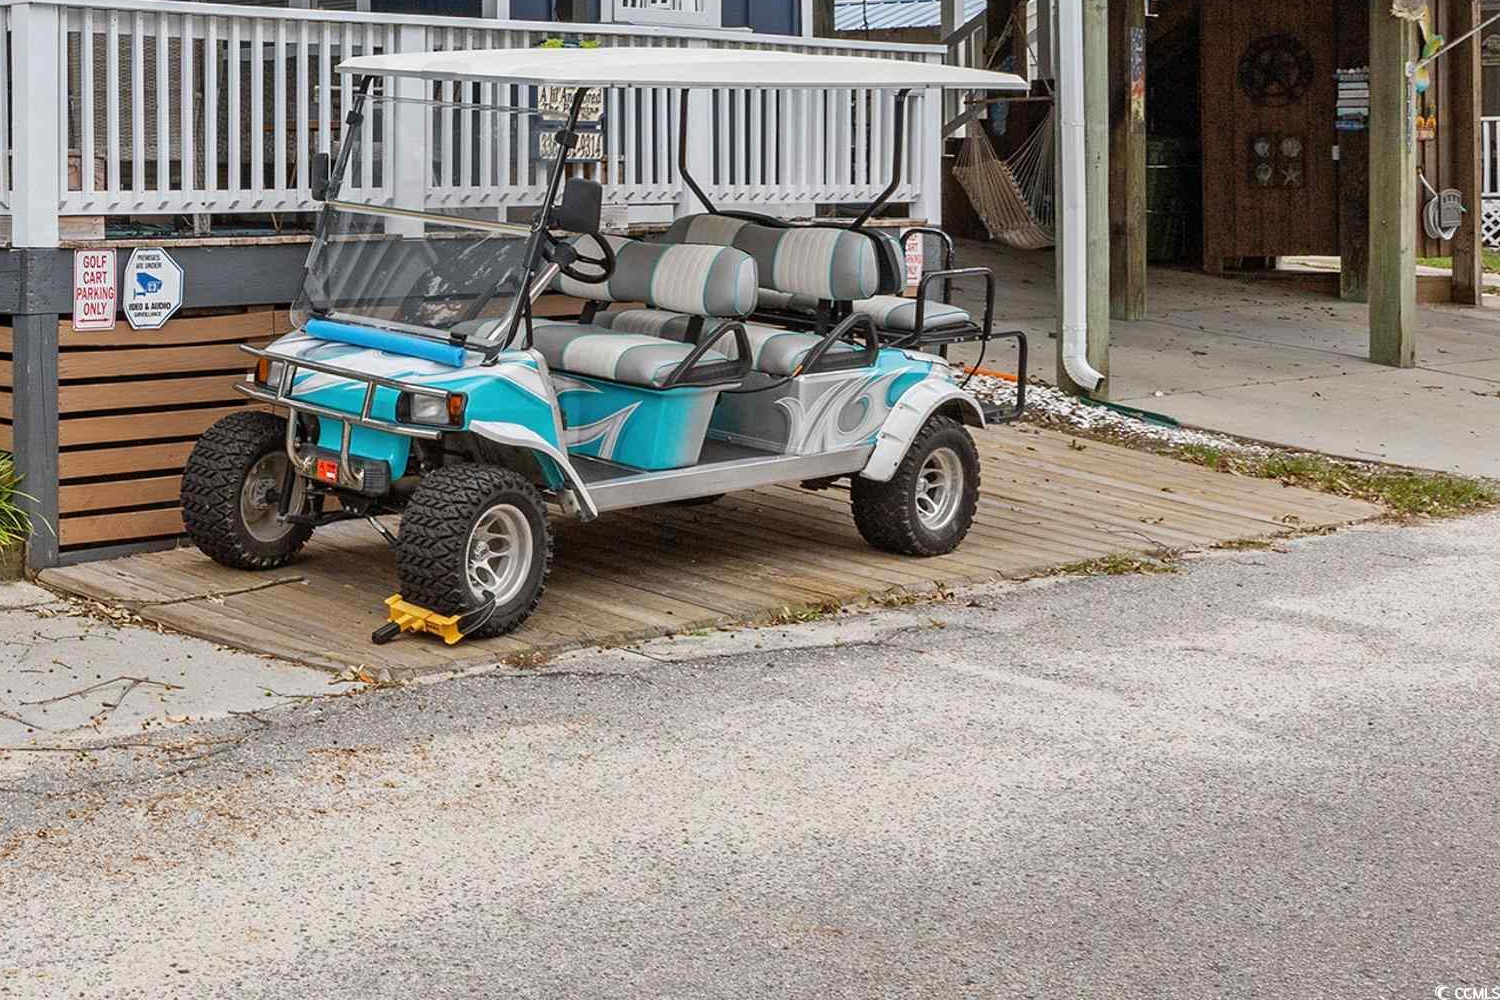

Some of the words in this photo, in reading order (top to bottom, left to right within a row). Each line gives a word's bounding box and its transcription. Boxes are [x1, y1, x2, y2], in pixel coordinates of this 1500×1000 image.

[83, 255, 107, 268] GOLF
[83, 271, 107, 284] CART
[76, 287, 115, 300] PARKING
[83, 302, 108, 316] ONLY
[128, 302, 143, 311] VIDEO
[145, 302, 150, 310] &
[151, 302, 171, 310] AUDIO
